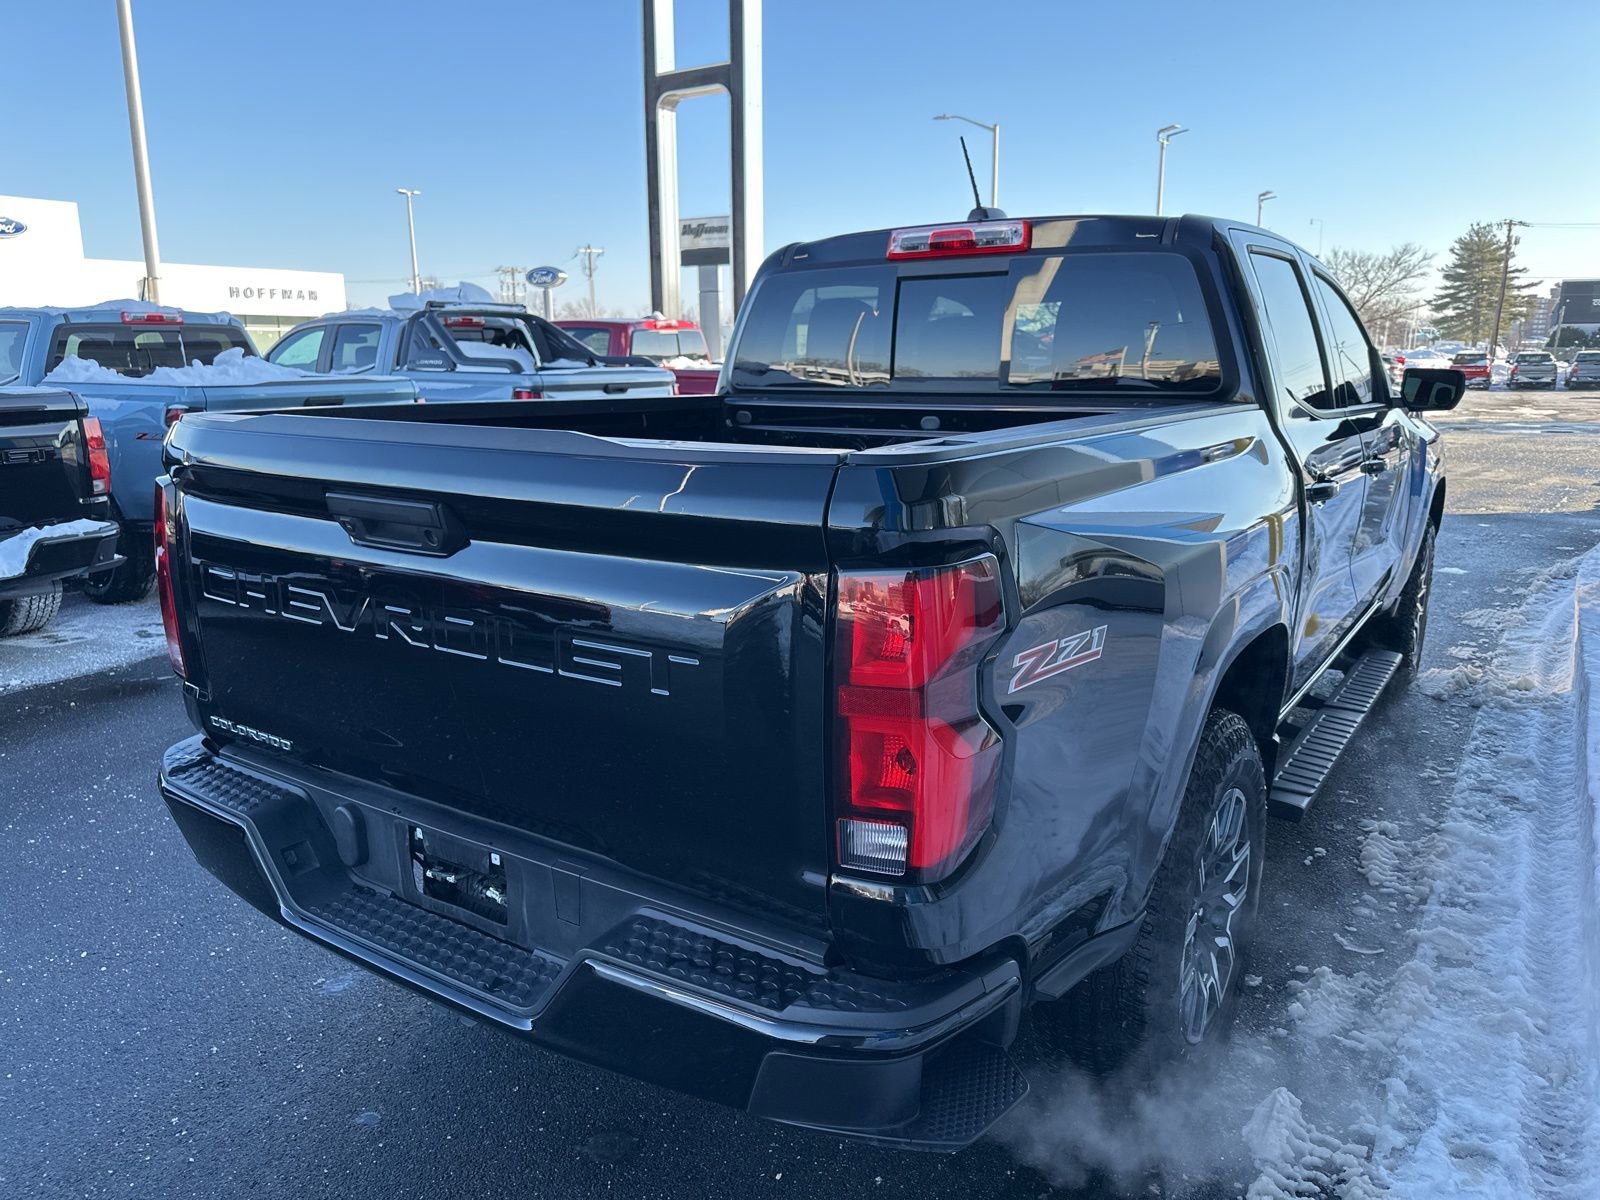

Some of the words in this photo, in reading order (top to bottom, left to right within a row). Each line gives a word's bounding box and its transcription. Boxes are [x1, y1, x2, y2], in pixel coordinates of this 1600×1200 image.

[229, 286, 318, 301] HOFFMAN
[200, 560, 700, 696] CHEVROLET
[1007, 624, 1108, 695] Z71
[209, 715, 294, 751] COLORADO
